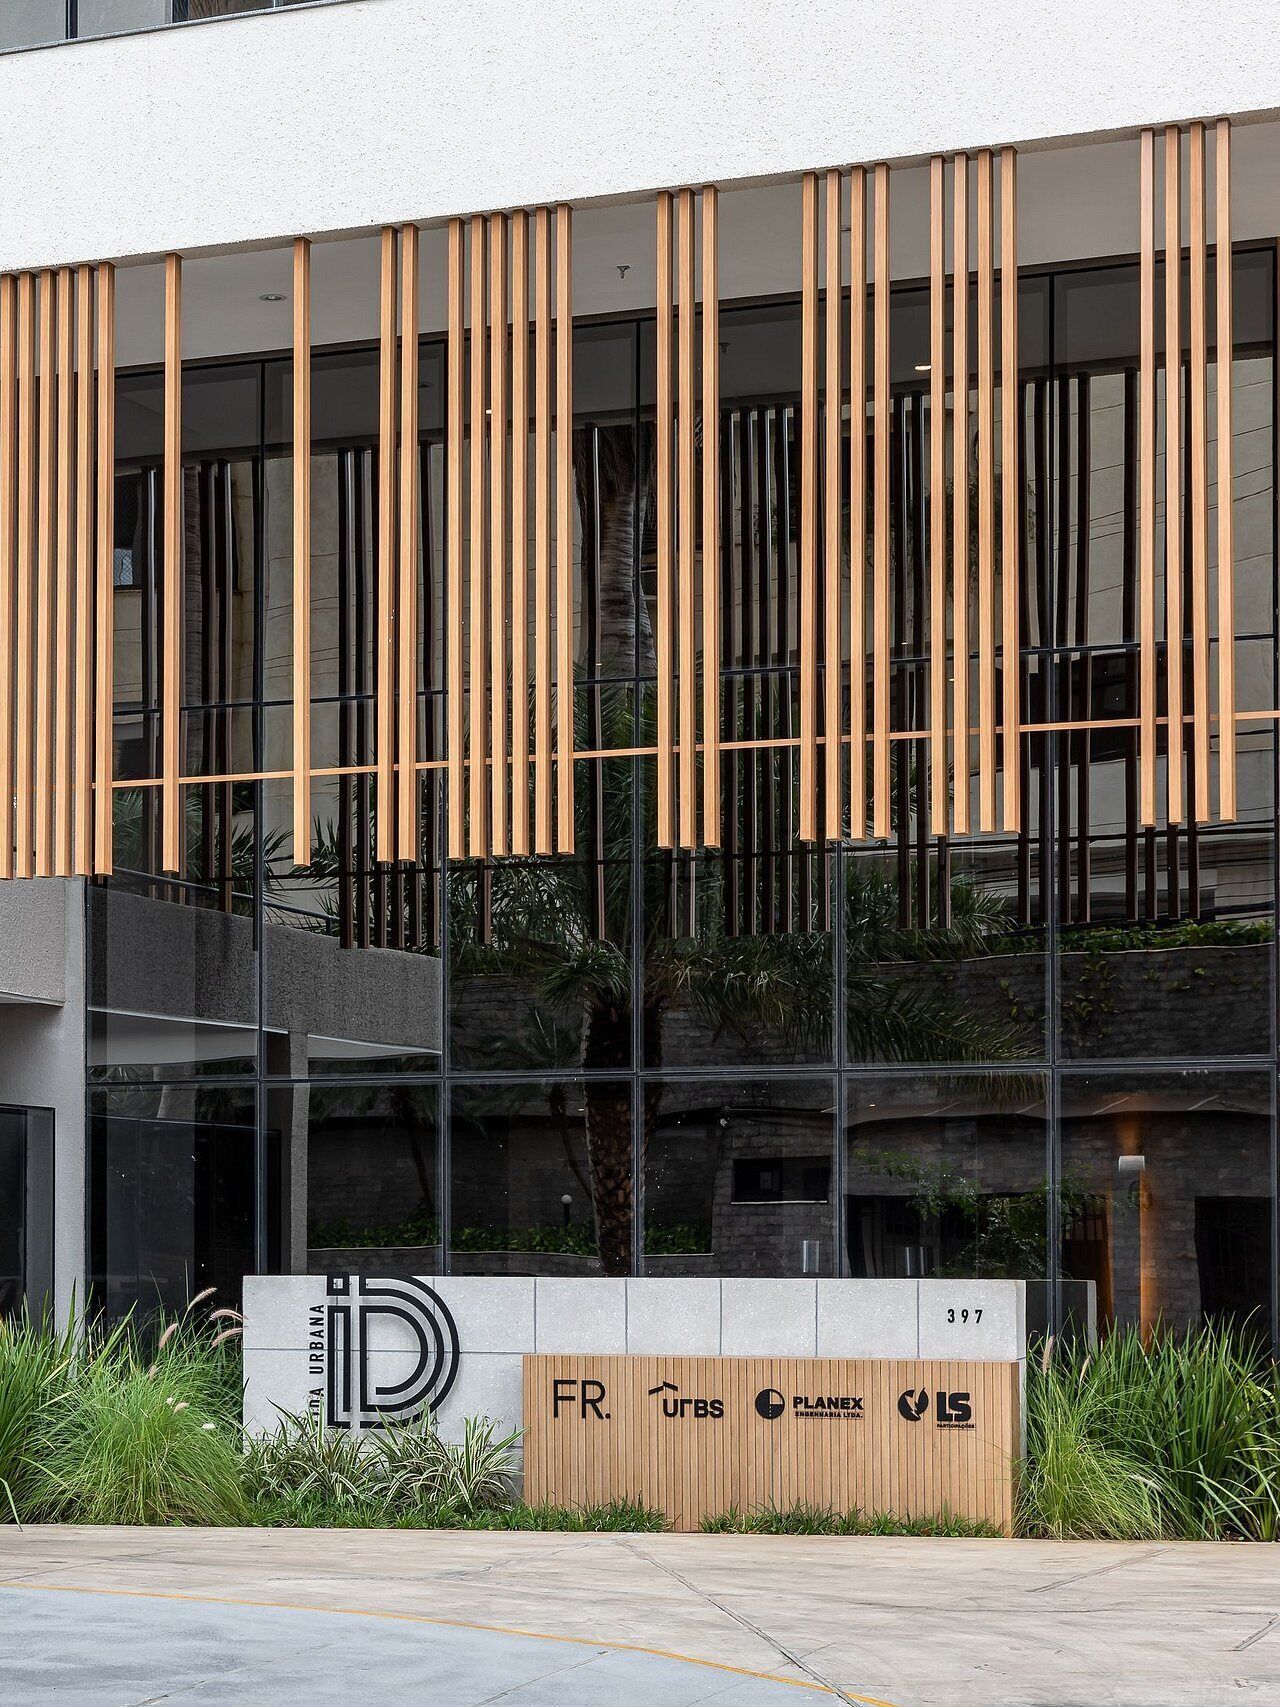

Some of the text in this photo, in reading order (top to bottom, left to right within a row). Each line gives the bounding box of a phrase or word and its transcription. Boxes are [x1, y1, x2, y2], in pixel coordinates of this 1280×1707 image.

[946, 1308, 983, 1324] 397
[308, 1304, 325, 1375] URBANA
[553, 1379, 611, 1420] FR.
[792, 1396, 864, 1410] PLANEX
[936, 1391, 972, 1422] LS
